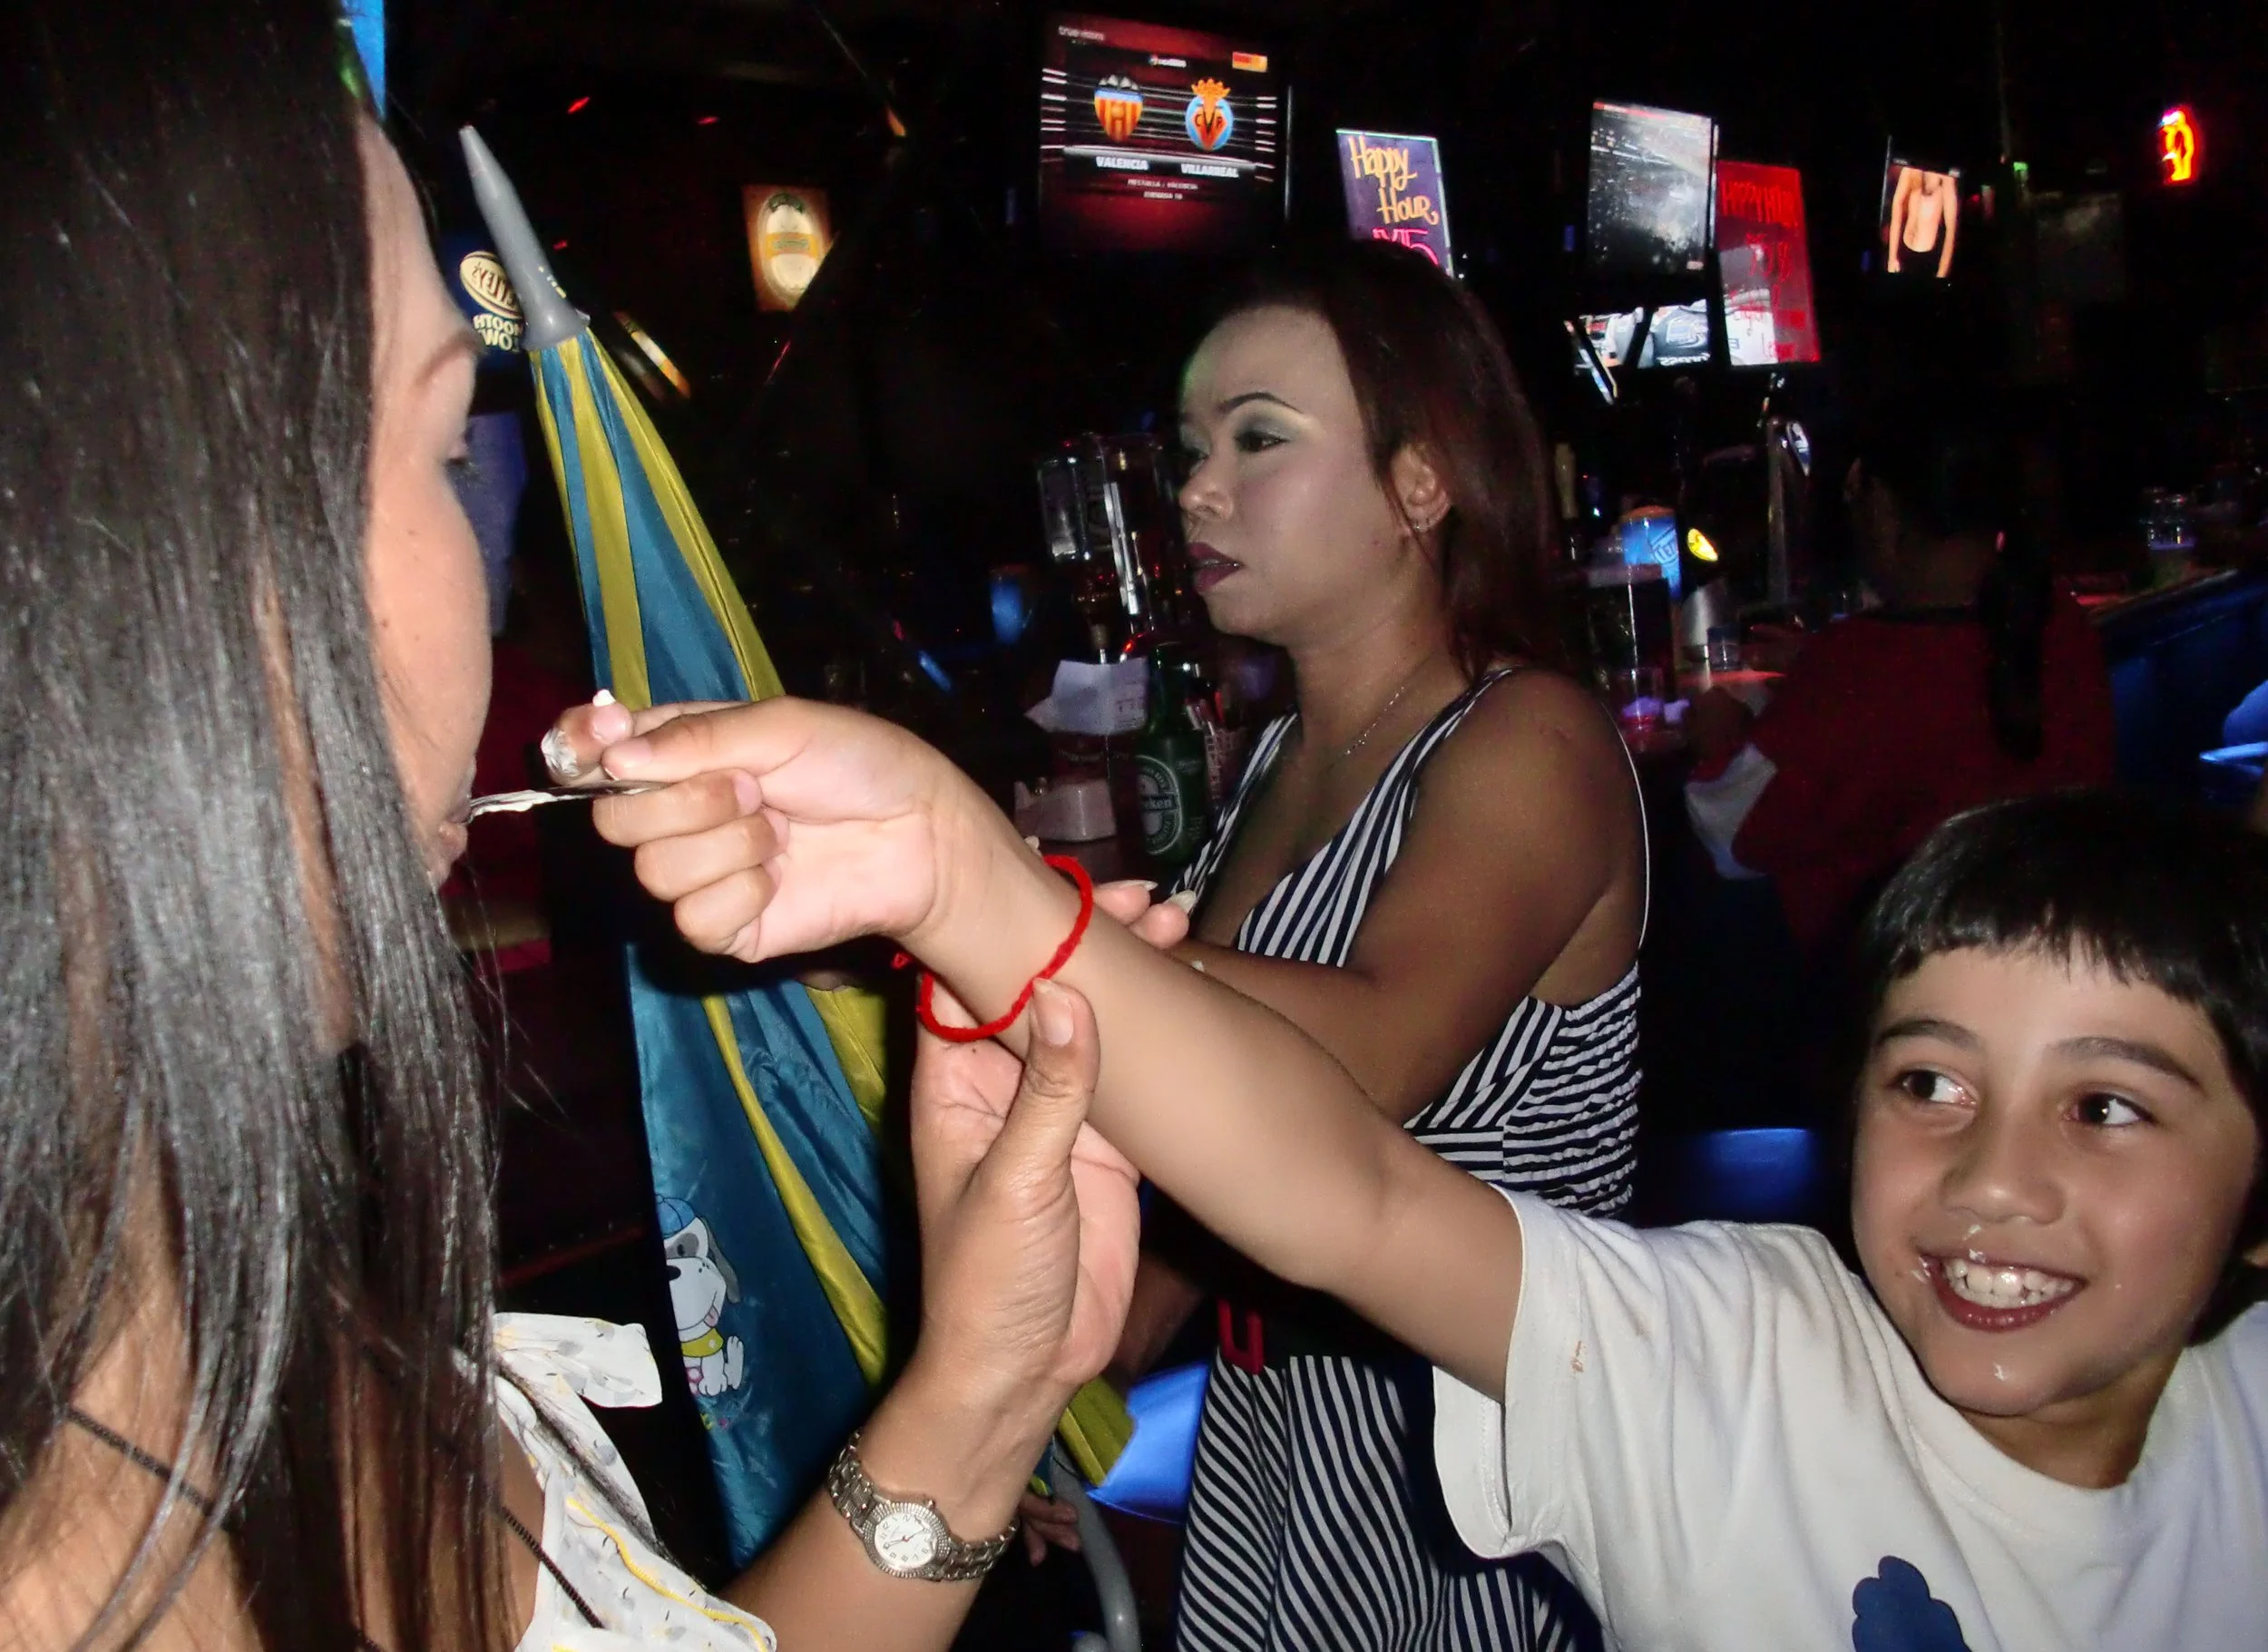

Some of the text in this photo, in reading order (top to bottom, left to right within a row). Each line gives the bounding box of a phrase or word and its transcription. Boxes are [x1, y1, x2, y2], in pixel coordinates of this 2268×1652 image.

[1096, 156, 1239, 178] VALENCIA VILLARREAL
[1349, 134, 1418, 191] Happy
